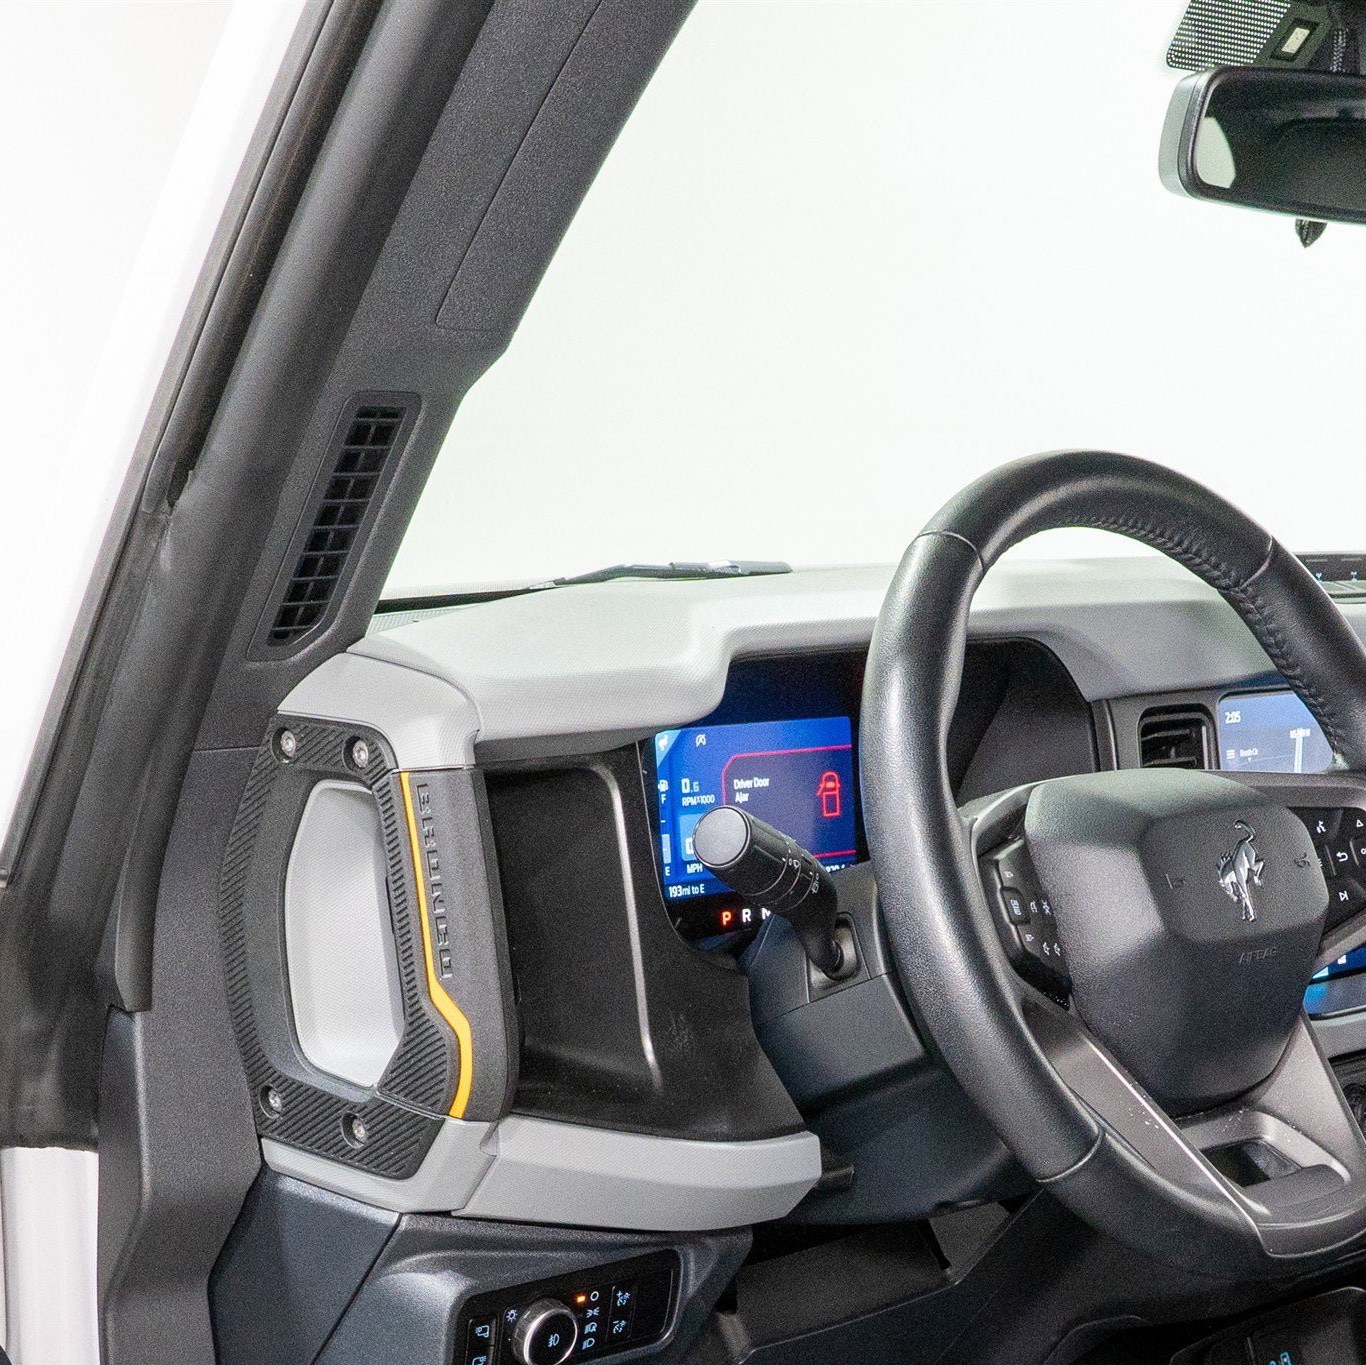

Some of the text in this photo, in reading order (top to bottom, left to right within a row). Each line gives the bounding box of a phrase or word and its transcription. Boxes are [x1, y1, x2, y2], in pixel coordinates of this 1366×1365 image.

[733, 777, 770, 790] Driver Door
[661, 794, 667, 804] F
[735, 792, 749, 804] Ajar
[665, 866, 671, 877] E
[686, 863, 703, 874] MPH
[722, 911, 732, 926] P
[742, 908, 751, 922] R
